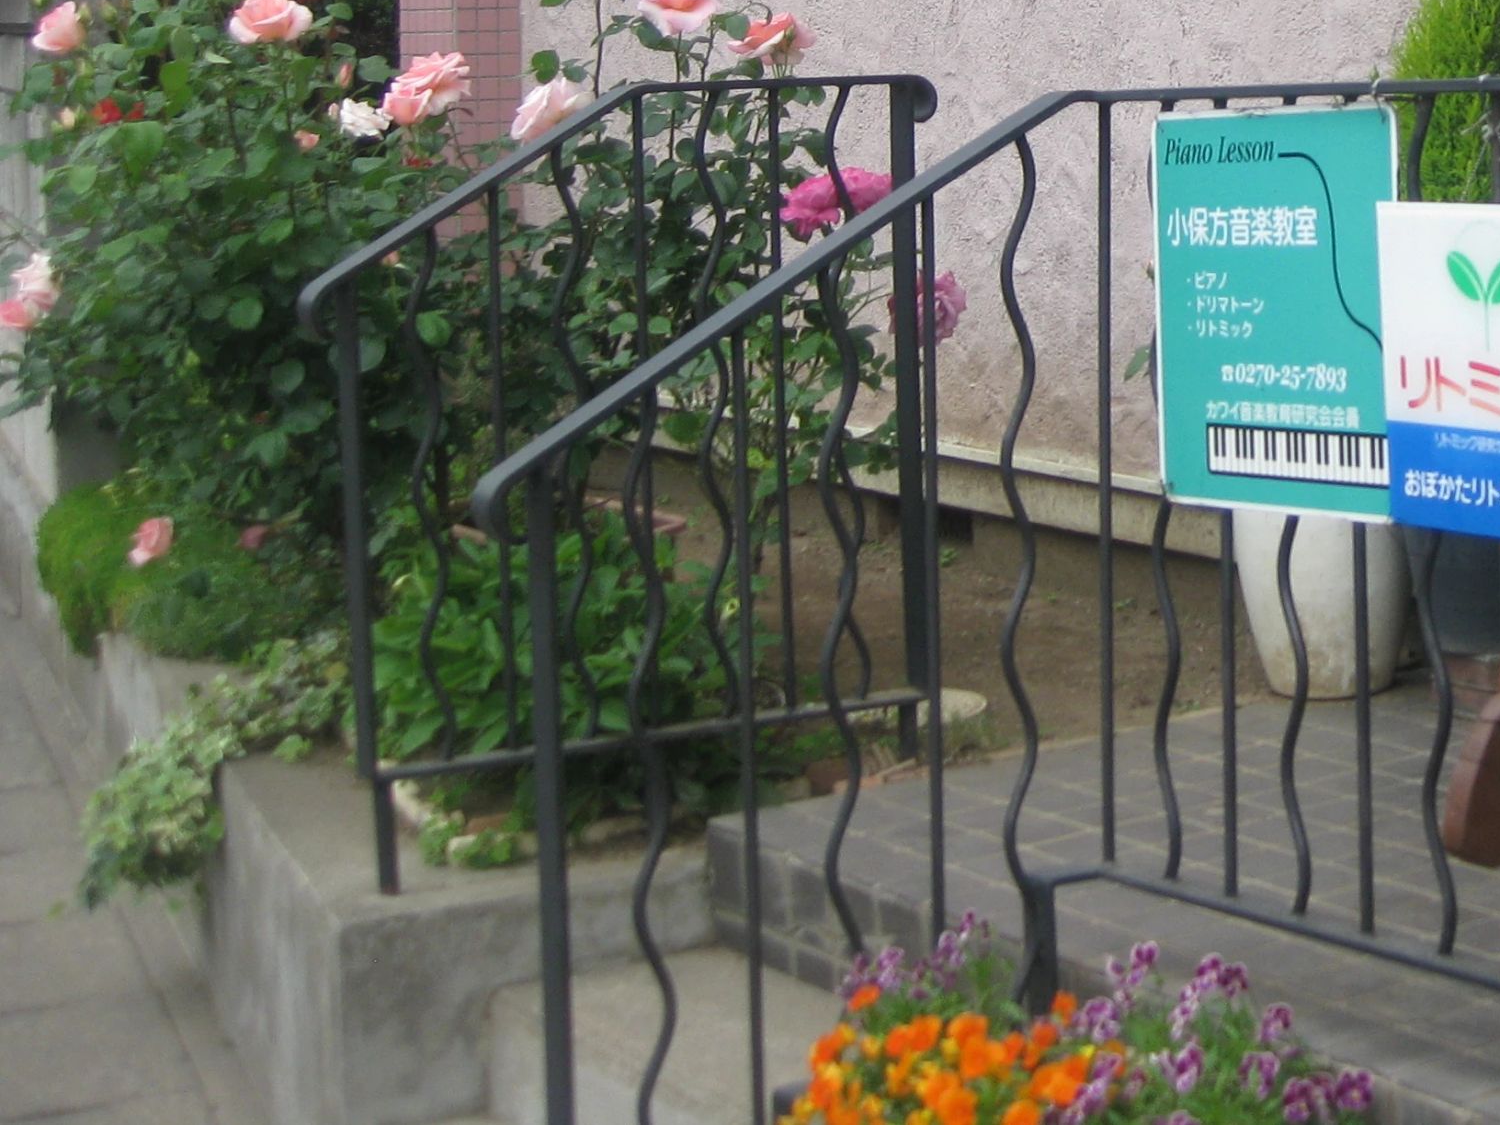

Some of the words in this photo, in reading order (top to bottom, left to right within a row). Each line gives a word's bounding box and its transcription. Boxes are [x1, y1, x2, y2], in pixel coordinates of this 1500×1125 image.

[1164, 138, 1213, 166] Piano
[1217, 136, 1275, 164] Lesson
[1167, 206, 1318, 247] 小保方音楽教室
